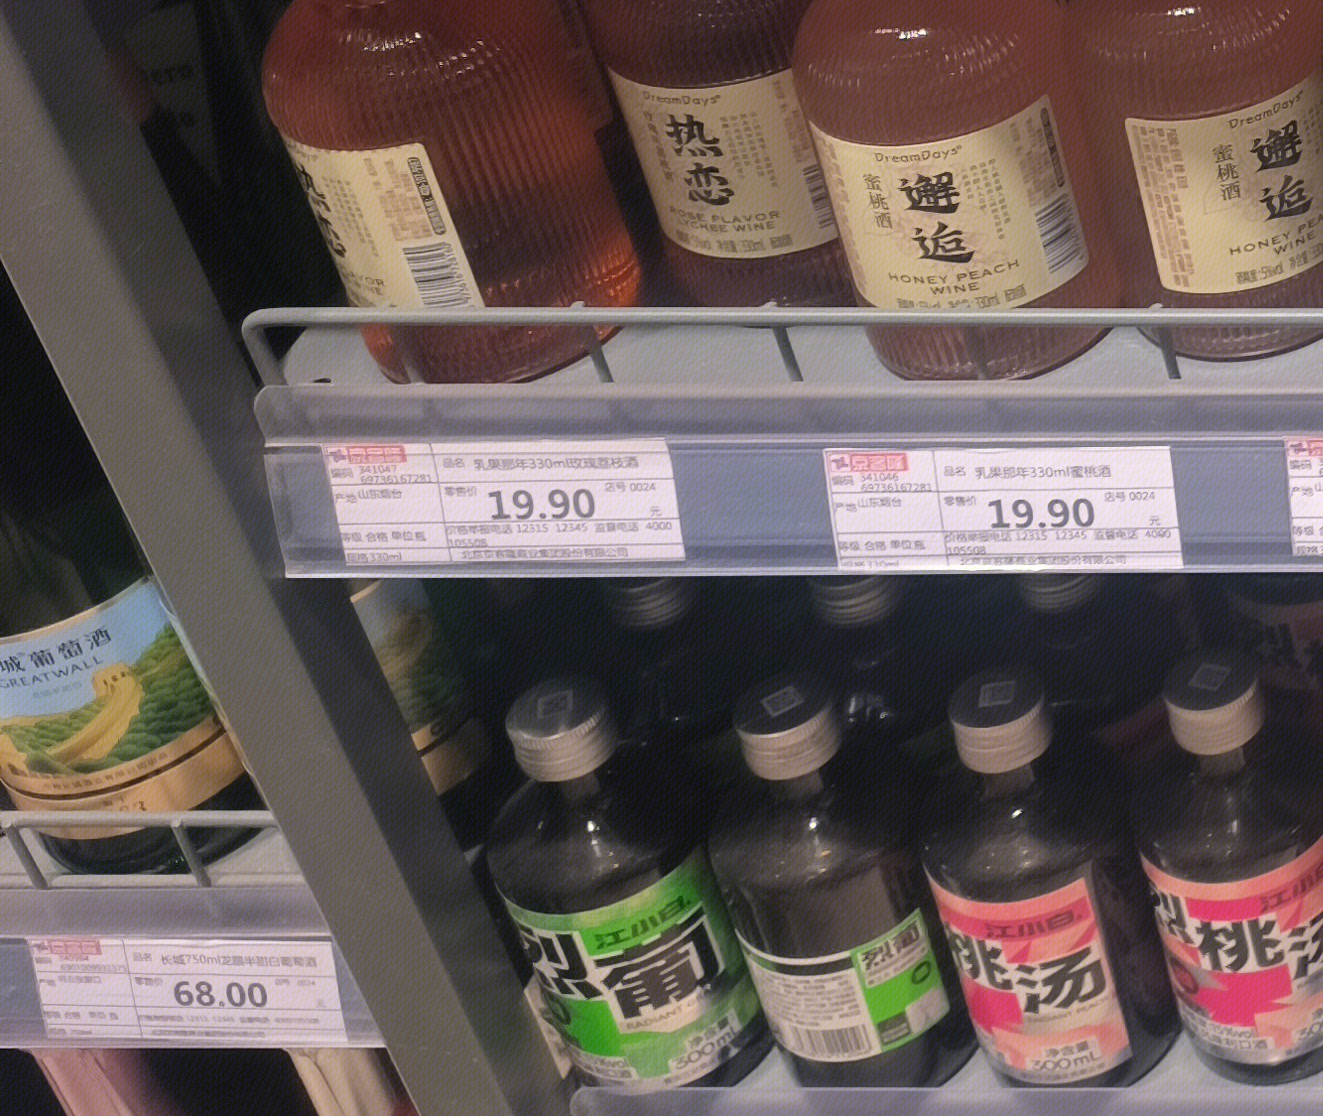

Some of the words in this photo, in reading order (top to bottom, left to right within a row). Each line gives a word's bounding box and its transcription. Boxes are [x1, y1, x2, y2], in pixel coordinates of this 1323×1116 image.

[666, 113, 735, 206] 热恋
[874, 145, 959, 163] DreamDays
[1212, 144, 1241, 201] 蜜桃酒
[1250, 119, 1314, 222] 邂逅
[901, 171, 974, 264] 邂逅
[1229, 239, 1281, 257] HONEY
[1274, 231, 1317, 256] WINE
[888, 272, 952, 286] HONEY
[957, 260, 1020, 282] PEACH
[930, 282, 979, 295] WINE
[487, 488, 596, 520] 19.90
[987, 498, 1095, 529] 19.90
[173, 981, 268, 1008] 68.00
[1031, 1053, 1100, 1071] 300mL
